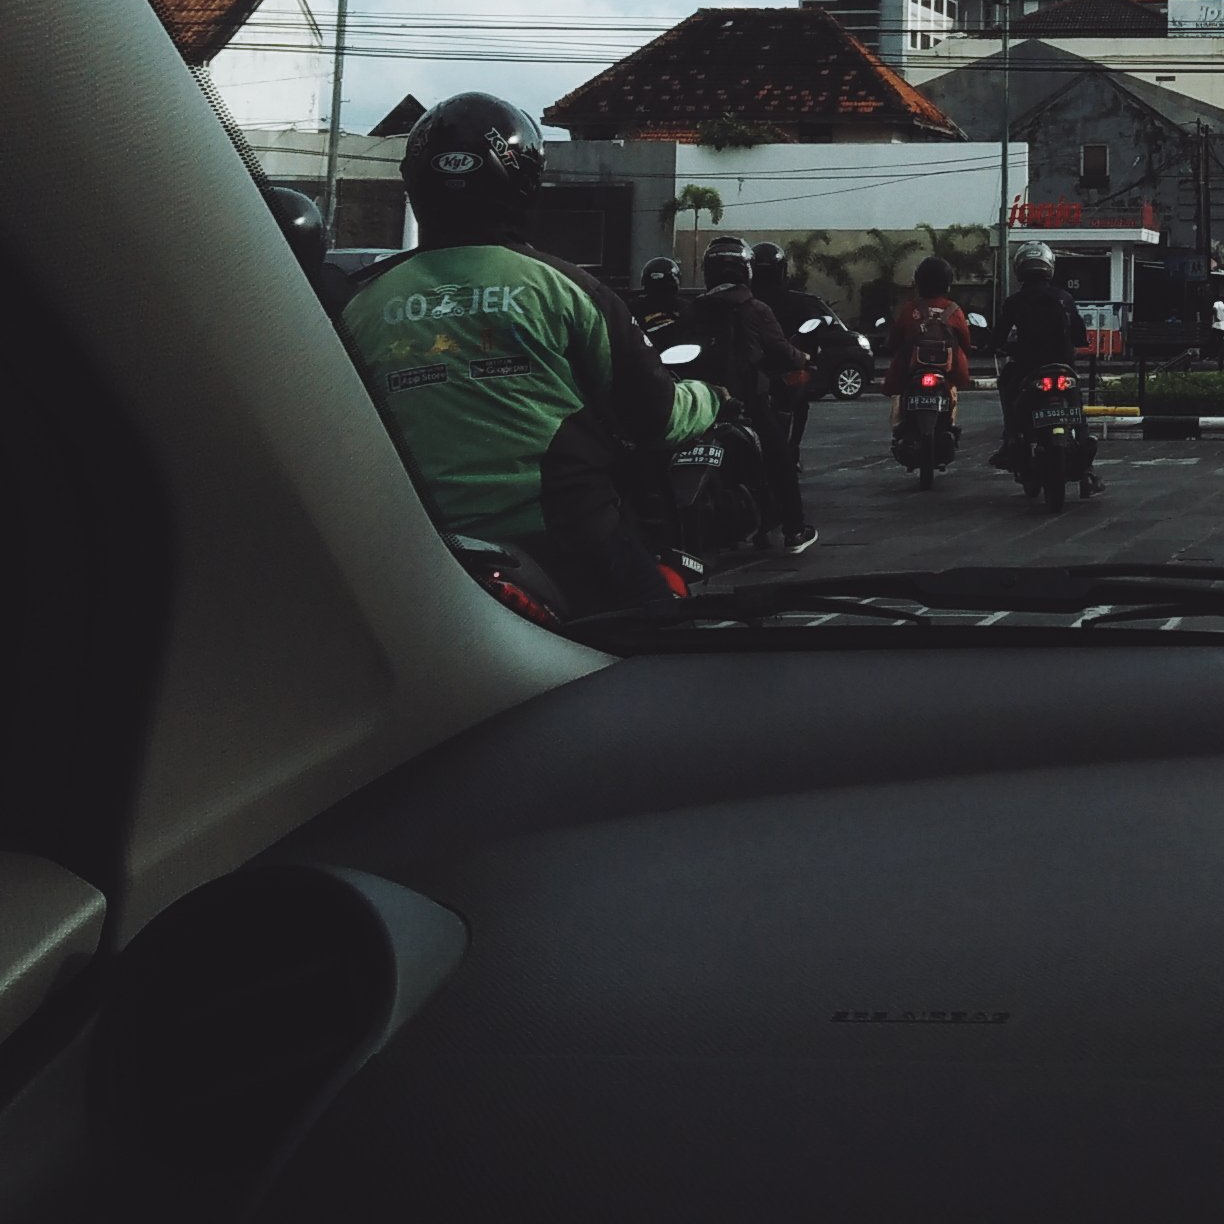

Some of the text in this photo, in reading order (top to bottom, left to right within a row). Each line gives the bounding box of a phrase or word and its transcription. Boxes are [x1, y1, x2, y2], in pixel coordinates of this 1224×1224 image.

[1067, 279, 1081, 290] 05
[384, 285, 526, 325] GO JEK
